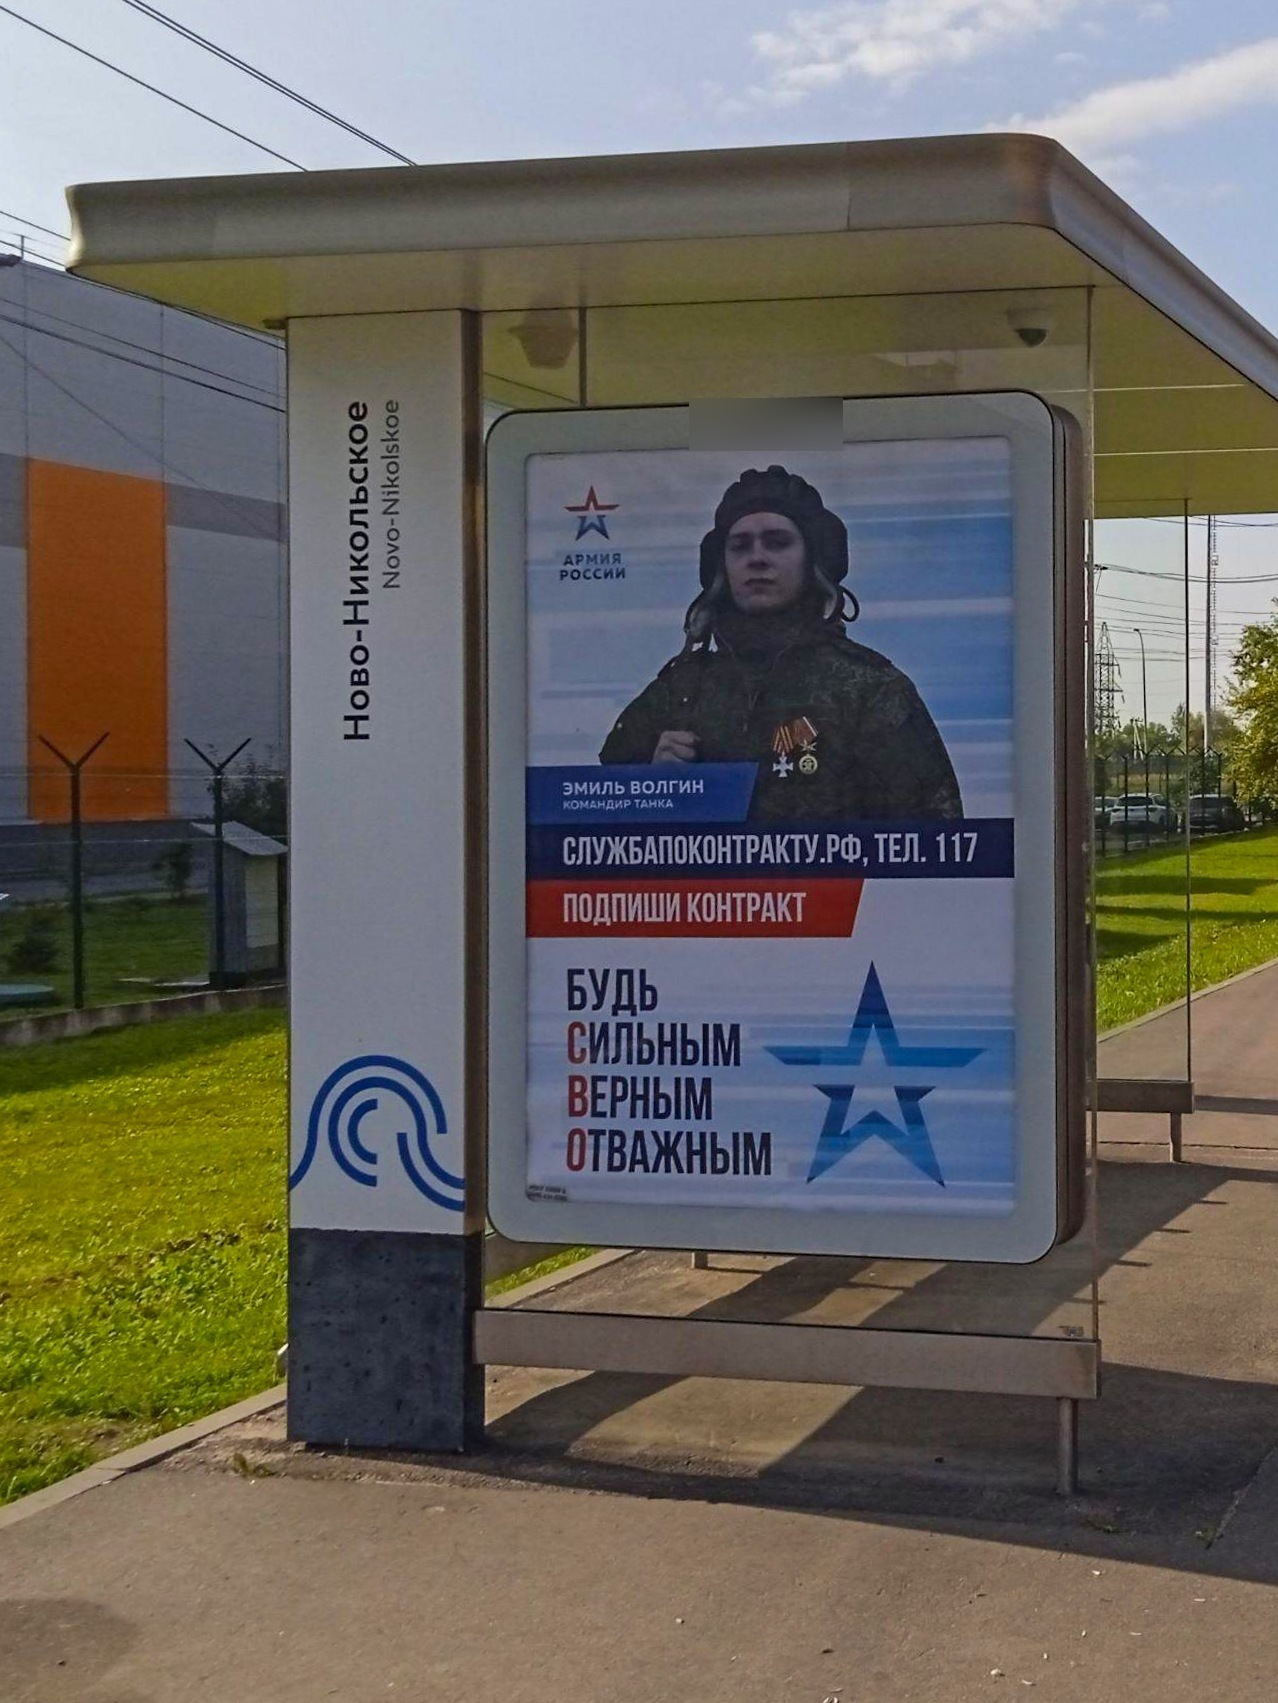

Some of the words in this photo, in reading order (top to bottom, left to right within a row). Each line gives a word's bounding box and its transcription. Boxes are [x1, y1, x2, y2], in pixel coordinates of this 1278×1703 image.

[381, 400, 400, 588] Novo-Nikolskoe
[343, 401, 370, 740] Ново-Никольское
[559, 567, 626, 581] РОССИИ
[563, 553, 622, 566] АРМИЯ
[562, 781, 625, 796] ЭМИЛЬ
[630, 779, 704, 795] ВОЛГИН
[563, 799, 630, 811] КОМАНДИР
[634, 799, 674, 809] ТАНКА
[562, 833, 868, 867] СЛУЖБАПОКОНТРАКТУ.РФ,
[874, 833, 927, 863] ТЕЛ.
[935, 832, 978, 863] 117
[563, 892, 680, 926] ПОДПИШИ
[687, 892, 807, 923] КОНТРАКТ
[567, 968, 658, 1016] БУДЬ
[567, 1021, 741, 1067] СИЛЬНЫМ
[568, 1075, 712, 1121] ВЕРНЫМ
[566, 1129, 772, 1176] ОТВАЖНЫМ
